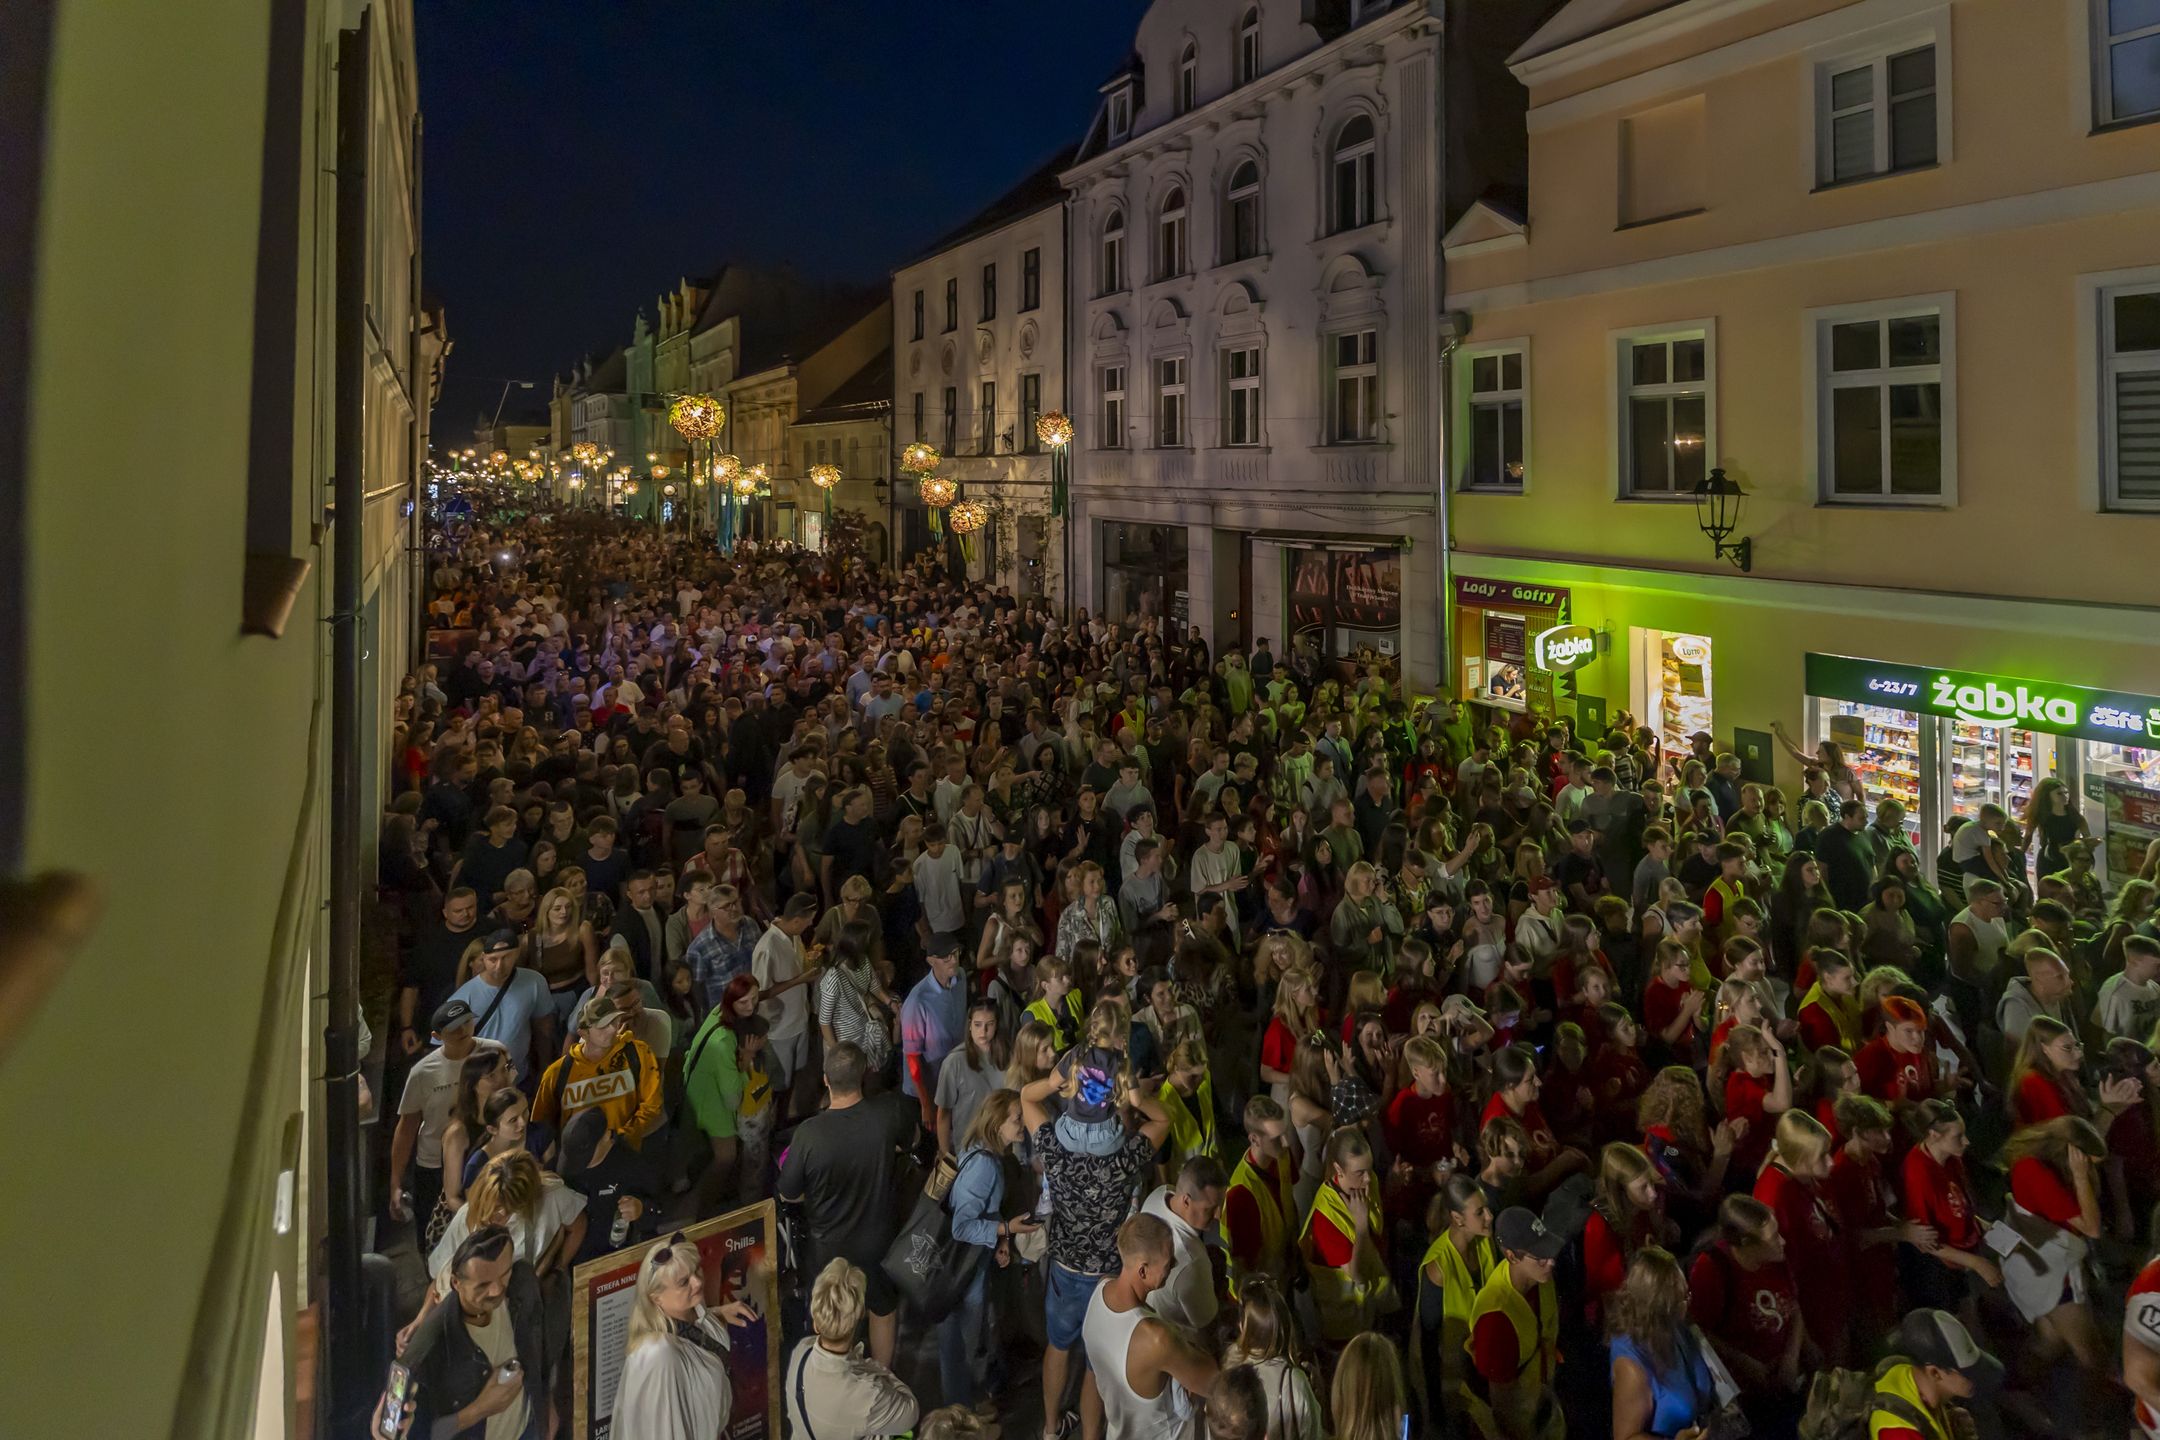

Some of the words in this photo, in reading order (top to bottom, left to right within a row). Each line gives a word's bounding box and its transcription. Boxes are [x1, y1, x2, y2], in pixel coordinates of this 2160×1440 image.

[1463, 581, 1496, 597] Lody
[1512, 586, 1556, 604] Gofry
[1547, 636, 1593, 660] żabka
[1868, 678, 1918, 696] 6-23/7
[1932, 676, 2077, 725] żabka
[563, 1074, 628, 1106] NASA
[596, 1279, 621, 1295] STREFA
